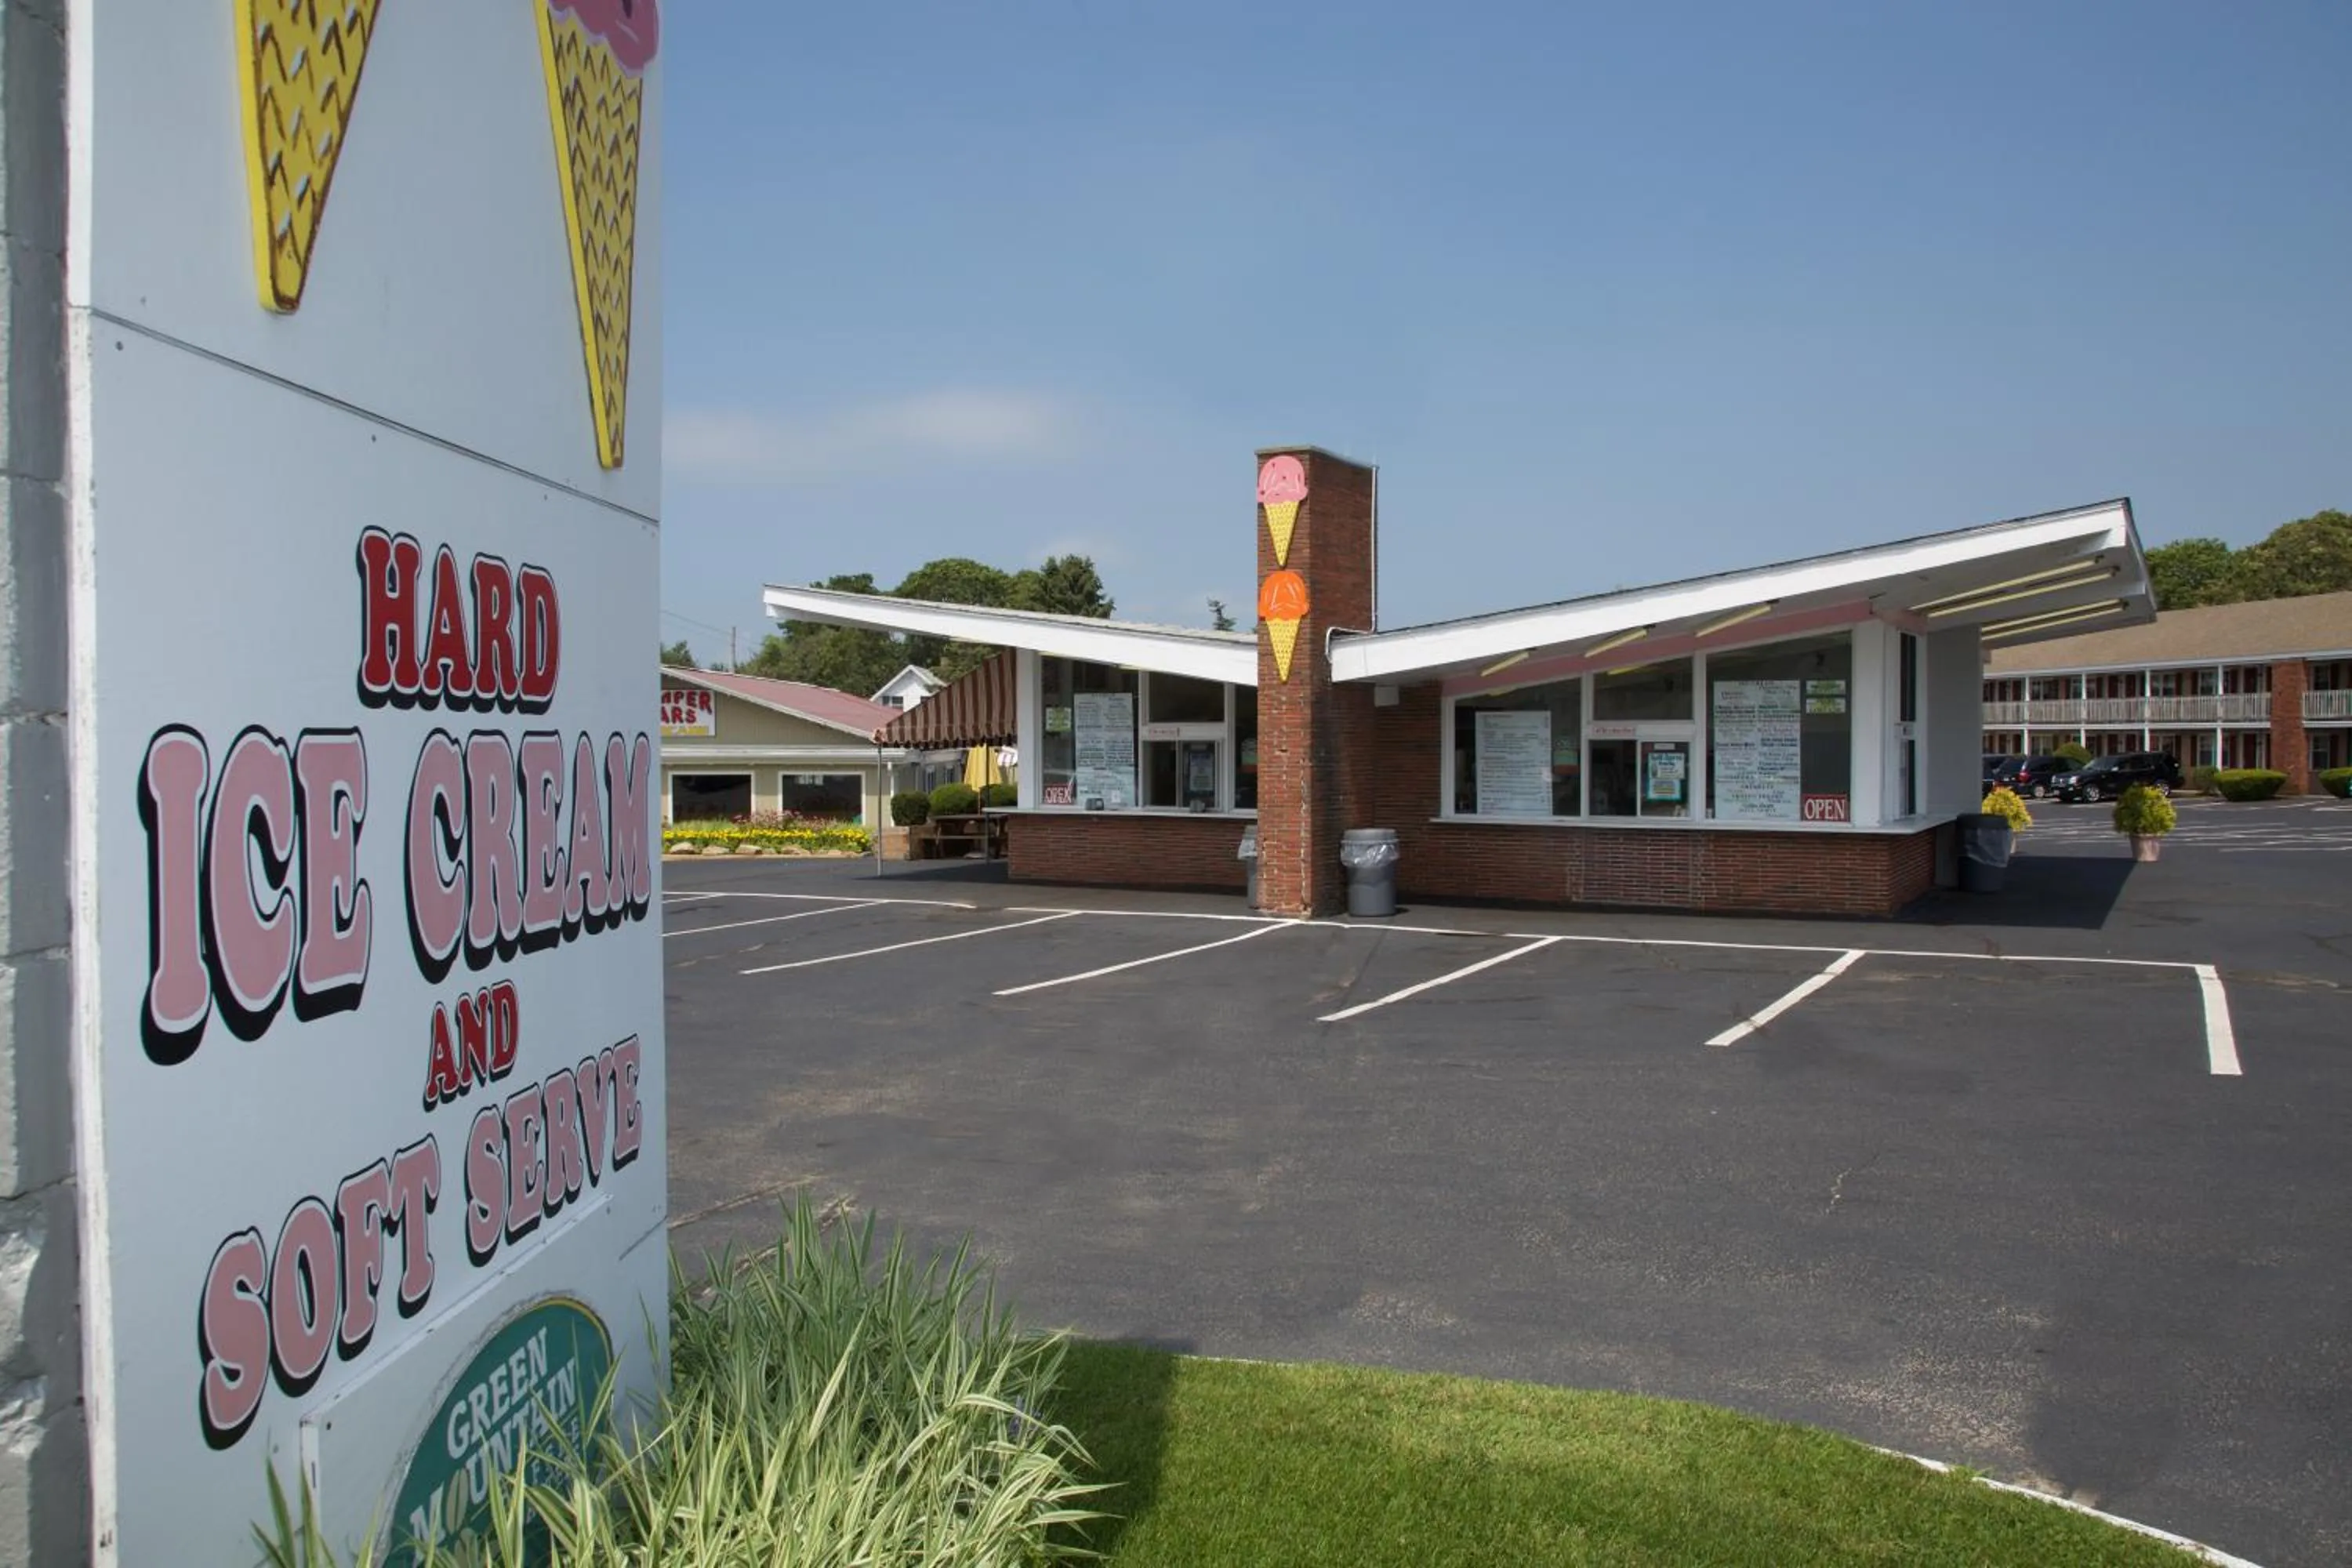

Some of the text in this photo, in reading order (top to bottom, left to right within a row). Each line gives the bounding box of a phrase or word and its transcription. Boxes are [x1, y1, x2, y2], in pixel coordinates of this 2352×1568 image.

[357, 525, 560, 714] HARD
[661, 706, 696, 724] ARS
[1805, 799, 1845, 820] OPEN
[138, 724, 652, 1066] ICE CREAM
[423, 979, 519, 1112] AND
[199, 1034, 642, 1451] SOFT SERVE
[447, 1326, 547, 1460] GREEN
